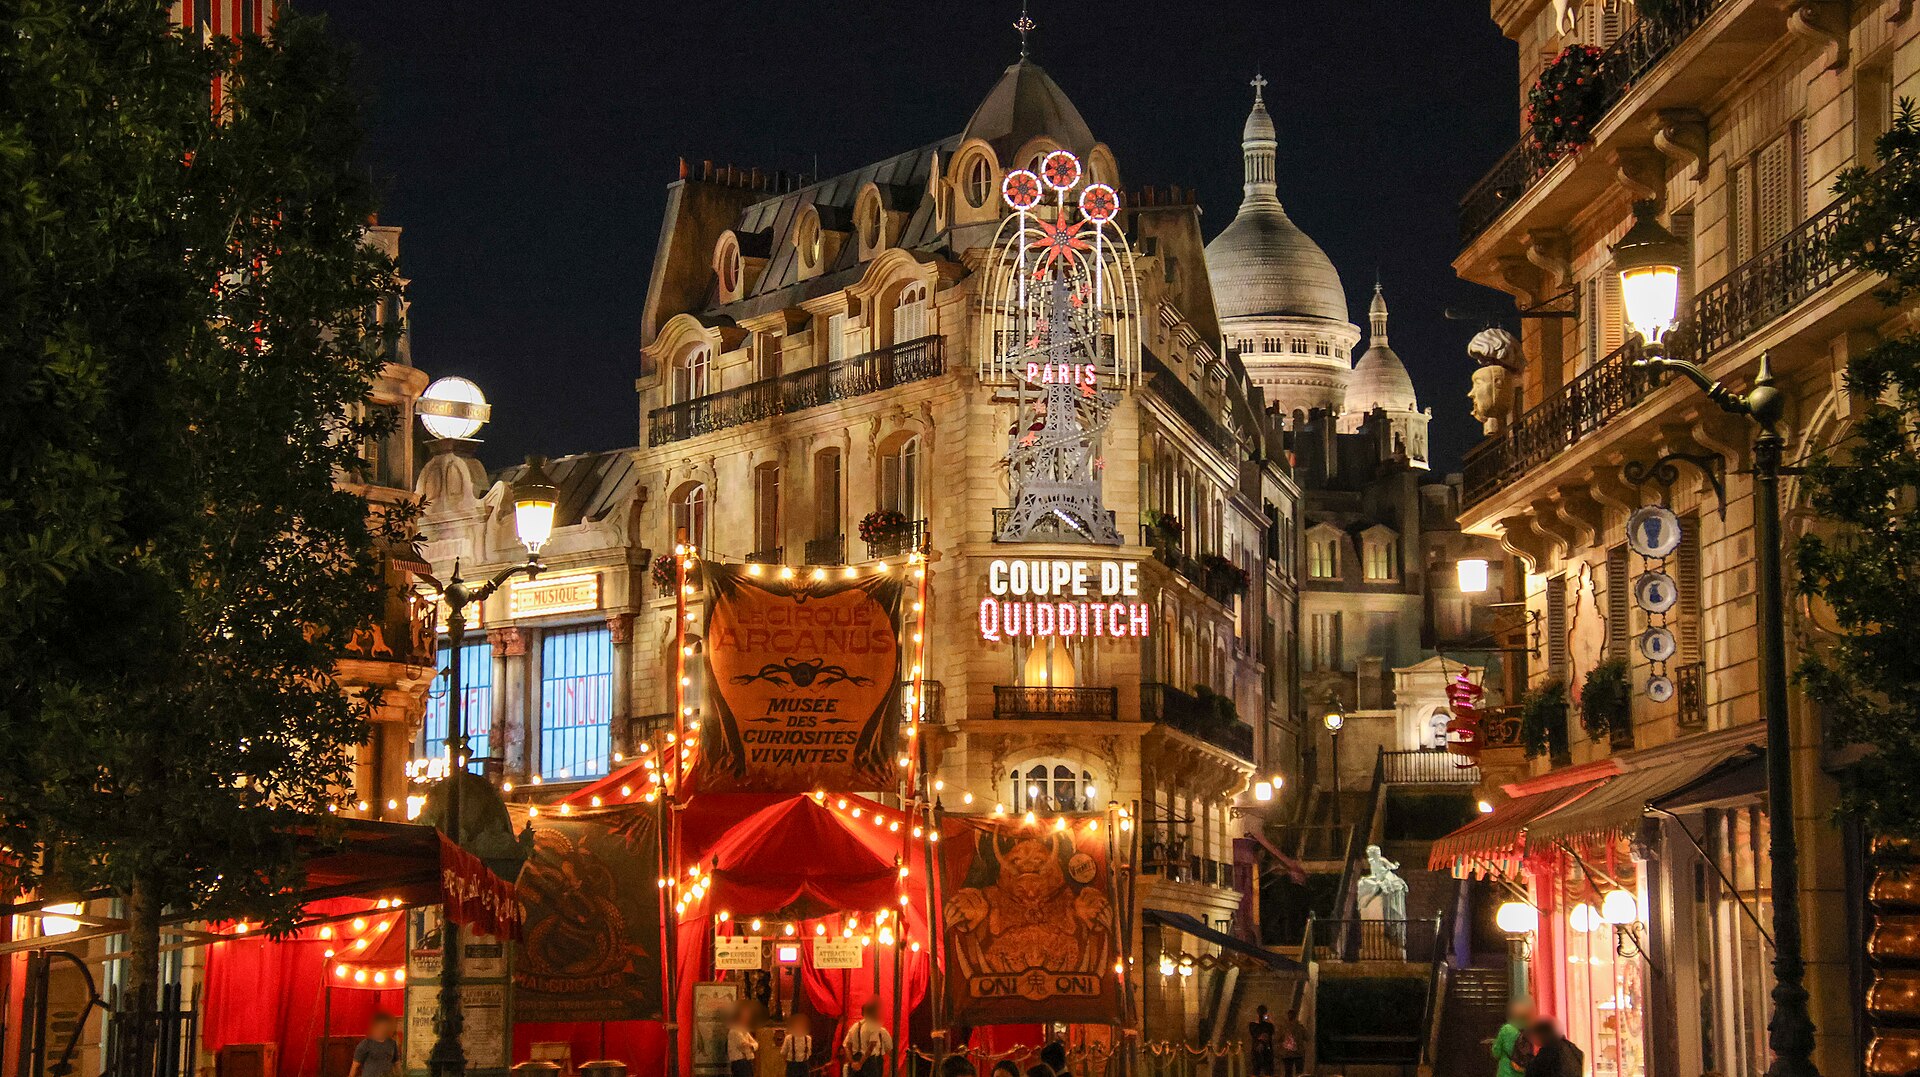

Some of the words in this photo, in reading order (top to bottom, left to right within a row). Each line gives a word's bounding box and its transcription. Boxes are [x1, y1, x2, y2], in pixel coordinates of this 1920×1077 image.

[1026, 362, 1097, 385] PARIS
[989, 559, 1088, 596] COUPE
[1100, 561, 1139, 596] DE
[534, 586, 579, 605] MUSIQUE
[766, 605, 874, 627] CIRQUE
[979, 597, 1149, 642] QUIDDITCH
[716, 628, 894, 654] ARCANUS
[767, 696, 840, 716] MUSÉE
[786, 716, 817, 728] DES
[742, 727, 859, 746] CURIOSITÉS
[750, 748, 849, 767] VIVANTES
[819, 950, 857, 958] ATTRACTION
[978, 976, 1018, 994] ONI
[1055, 976, 1093, 994] ONI
